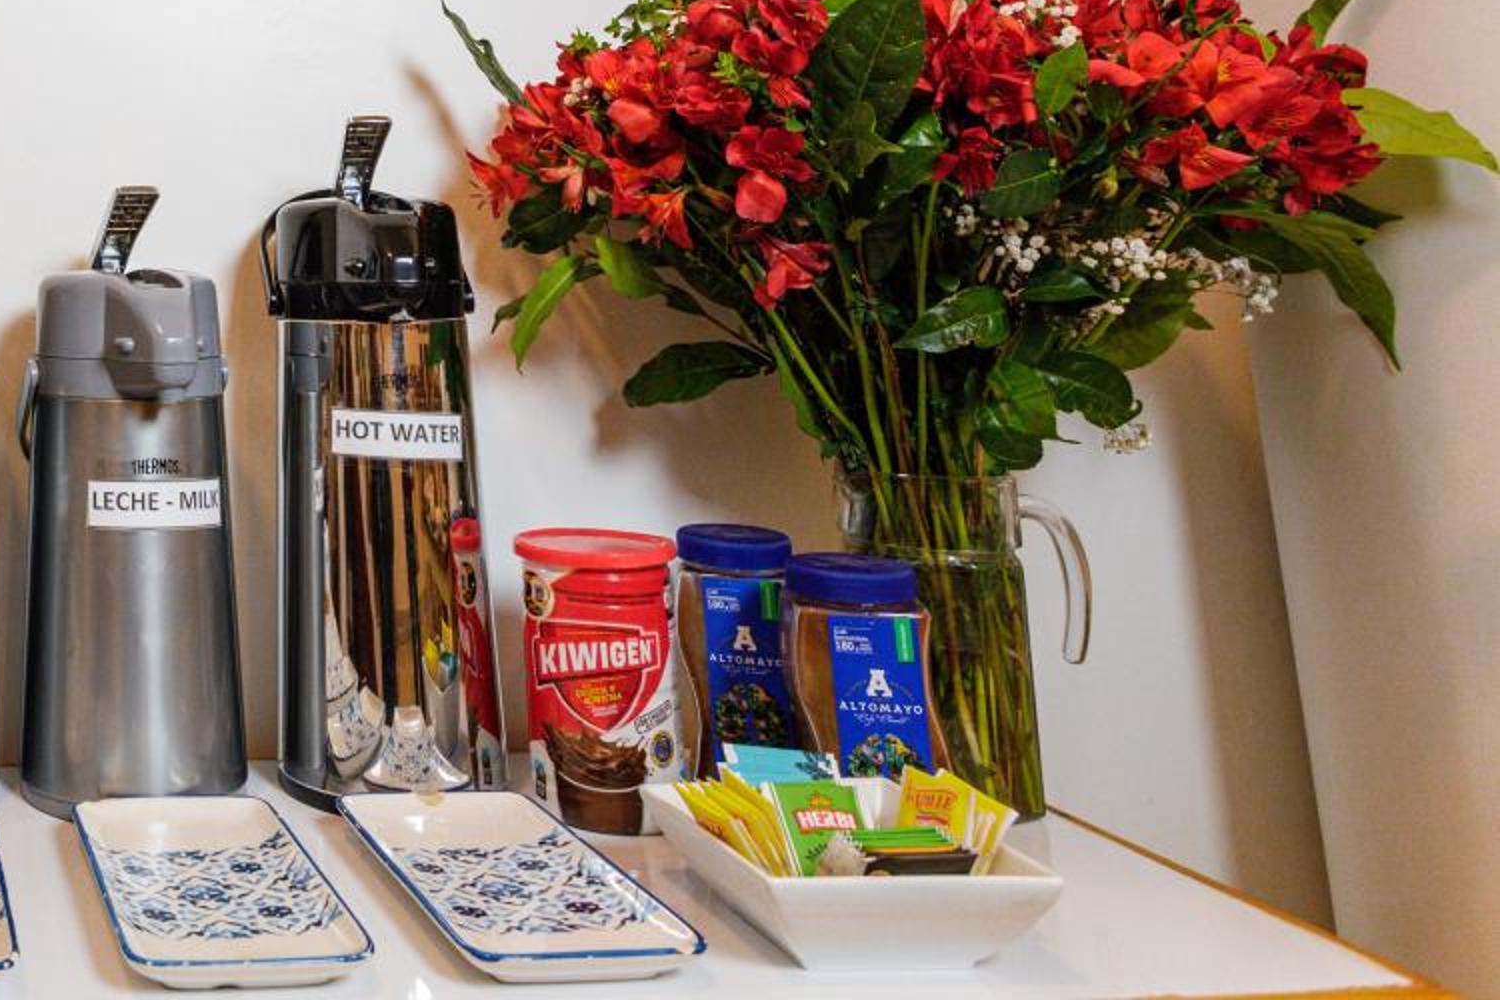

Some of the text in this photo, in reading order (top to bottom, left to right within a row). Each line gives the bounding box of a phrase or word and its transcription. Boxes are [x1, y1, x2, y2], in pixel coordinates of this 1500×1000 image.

[336, 419, 459, 443] HOT WATER
[131, 458, 180, 475] THERMOS
[93, 491, 160, 511] LECHE
[179, 489, 220, 510] MILK
[539, 637, 652, 675] KIWIGEN
[866, 669, 893, 697] A
[839, 700, 924, 715] ALTOMAYO
